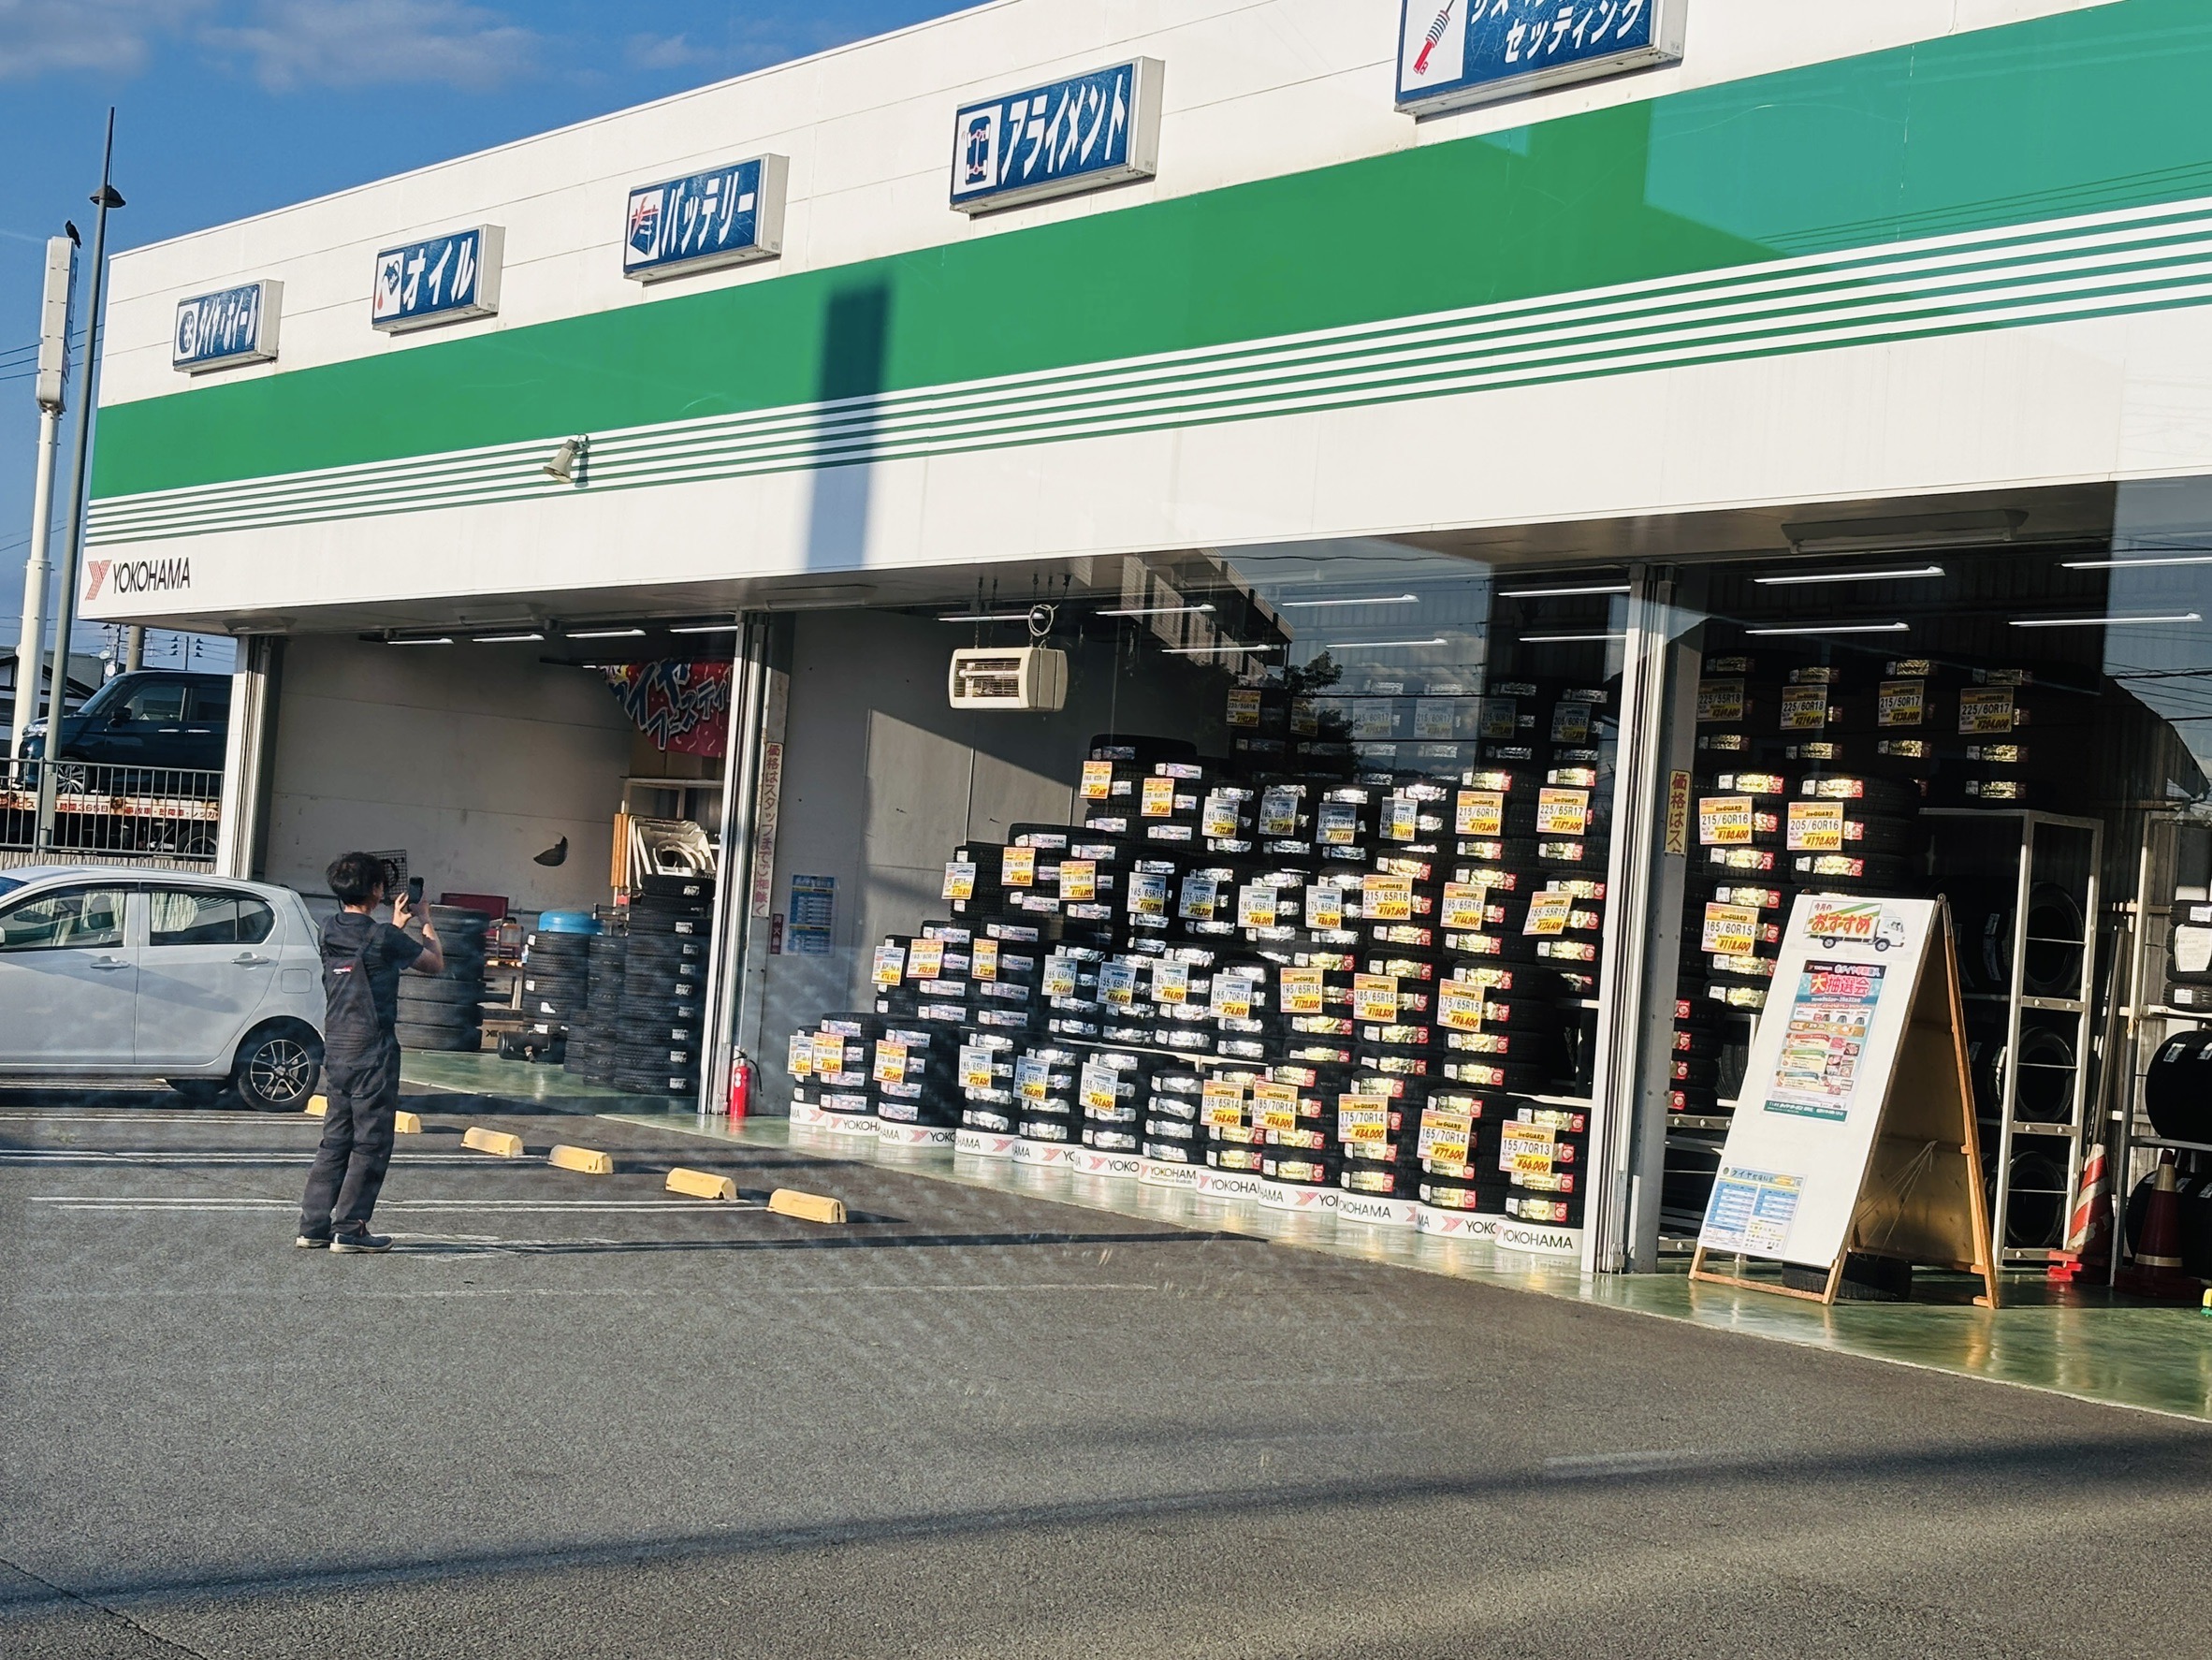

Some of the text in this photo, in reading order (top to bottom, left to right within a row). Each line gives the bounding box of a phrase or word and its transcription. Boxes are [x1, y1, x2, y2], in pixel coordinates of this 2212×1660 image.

[1505, 0, 1643, 63] セッティング
[1000, 74, 1126, 185] アライメント
[661, 170, 755, 257] バッテリー
[402, 237, 475, 312] オイル
[113, 557, 190, 594] YOKOHAMA
[1783, 702, 1824, 712] 225/60R18
[1880, 696, 1920, 708] 215/50R17
[1961, 703, 2010, 715] 225/60R17
[1459, 808, 1499, 817] 215/60R17
[1540, 805, 1583, 816] 225/65R17
[1667, 772, 1687, 852] 価格はス
[1702, 814, 1749, 825] 215/60R16
[1790, 820, 1839, 831] 205/60R16
[1364, 891, 1409, 901] 215/65R16
[1706, 920, 1753, 936] 165/60R15
[1811, 912, 1872, 935] おすすめ
[1356, 990, 1394, 1003] 185/65R15
[1440, 997, 1480, 1012] 175/65R15
[1083, 1079, 1114, 1096] 155/70R13
[1203, 1097, 1240, 1109] 155/65R14
[1256, 1099, 1294, 1114] 185/70R14
[1341, 1112, 1384, 1123] 175/70R14
[1421, 1128, 1466, 1143] 165/70R14
[1503, 1139, 1550, 1156] 155/70R13
[1108, 1160, 1140, 1172] YOKO
[1150, 1166, 1198, 1179] YOKOHAM
[1211, 1178, 1260, 1194] YOKOHA
[1503, 1228, 1574, 1250] YOKOHAMA
